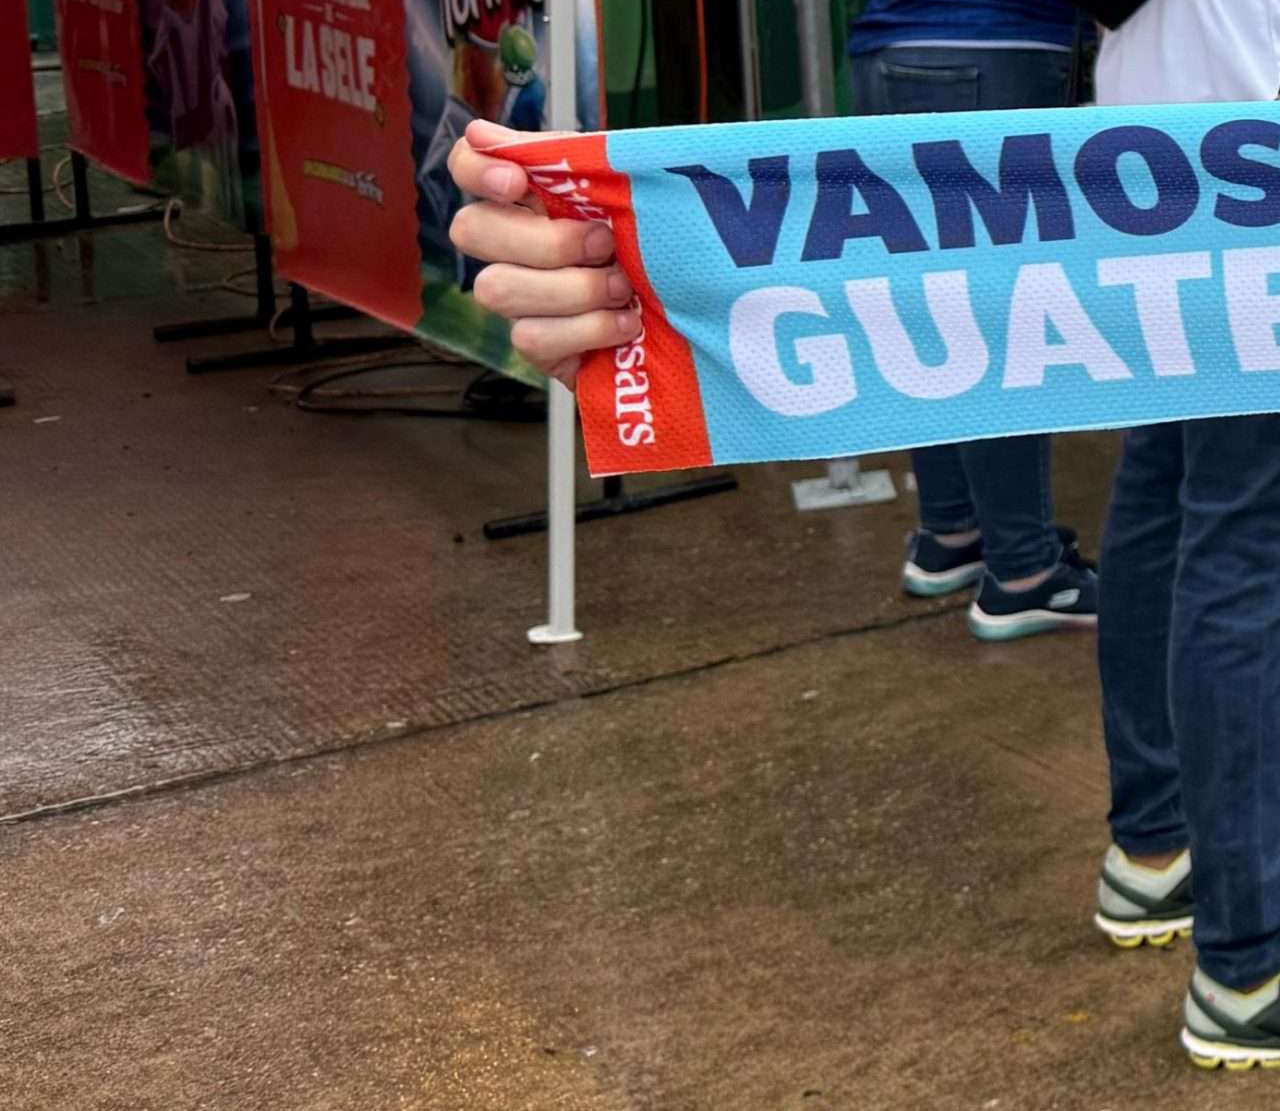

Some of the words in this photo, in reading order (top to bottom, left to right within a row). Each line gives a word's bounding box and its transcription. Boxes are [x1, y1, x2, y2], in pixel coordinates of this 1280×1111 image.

[285, 15, 322, 94] LA
[320, 25, 377, 113] SELE
[613, 293, 657, 447] sars
